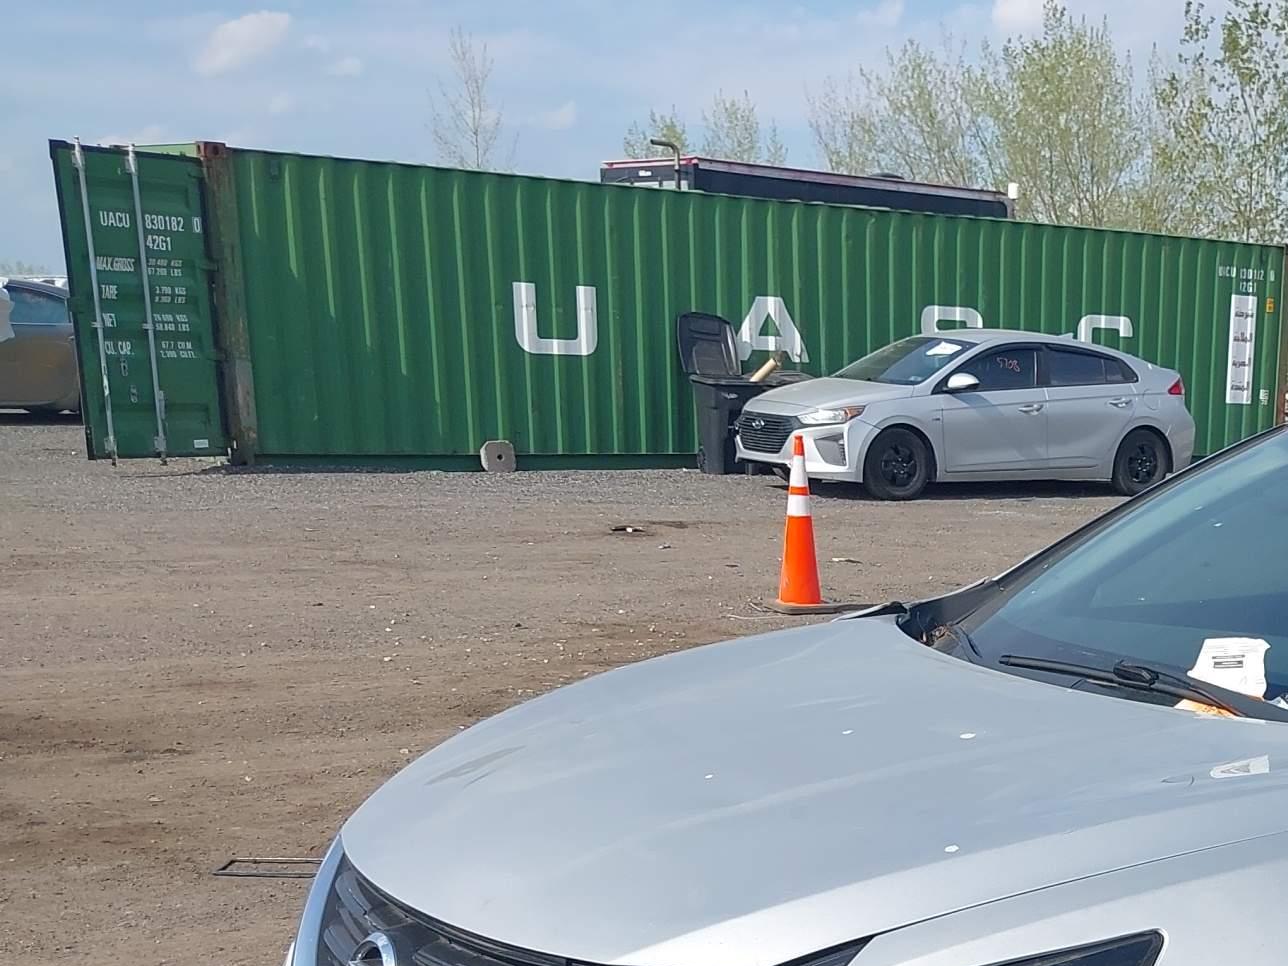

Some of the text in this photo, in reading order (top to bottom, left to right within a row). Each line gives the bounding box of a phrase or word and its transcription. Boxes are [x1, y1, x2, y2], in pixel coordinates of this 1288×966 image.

[99, 211, 201, 233] UACU 830182 0
[146, 234, 172, 251] 42G1
[100, 284, 118, 300] TARE
